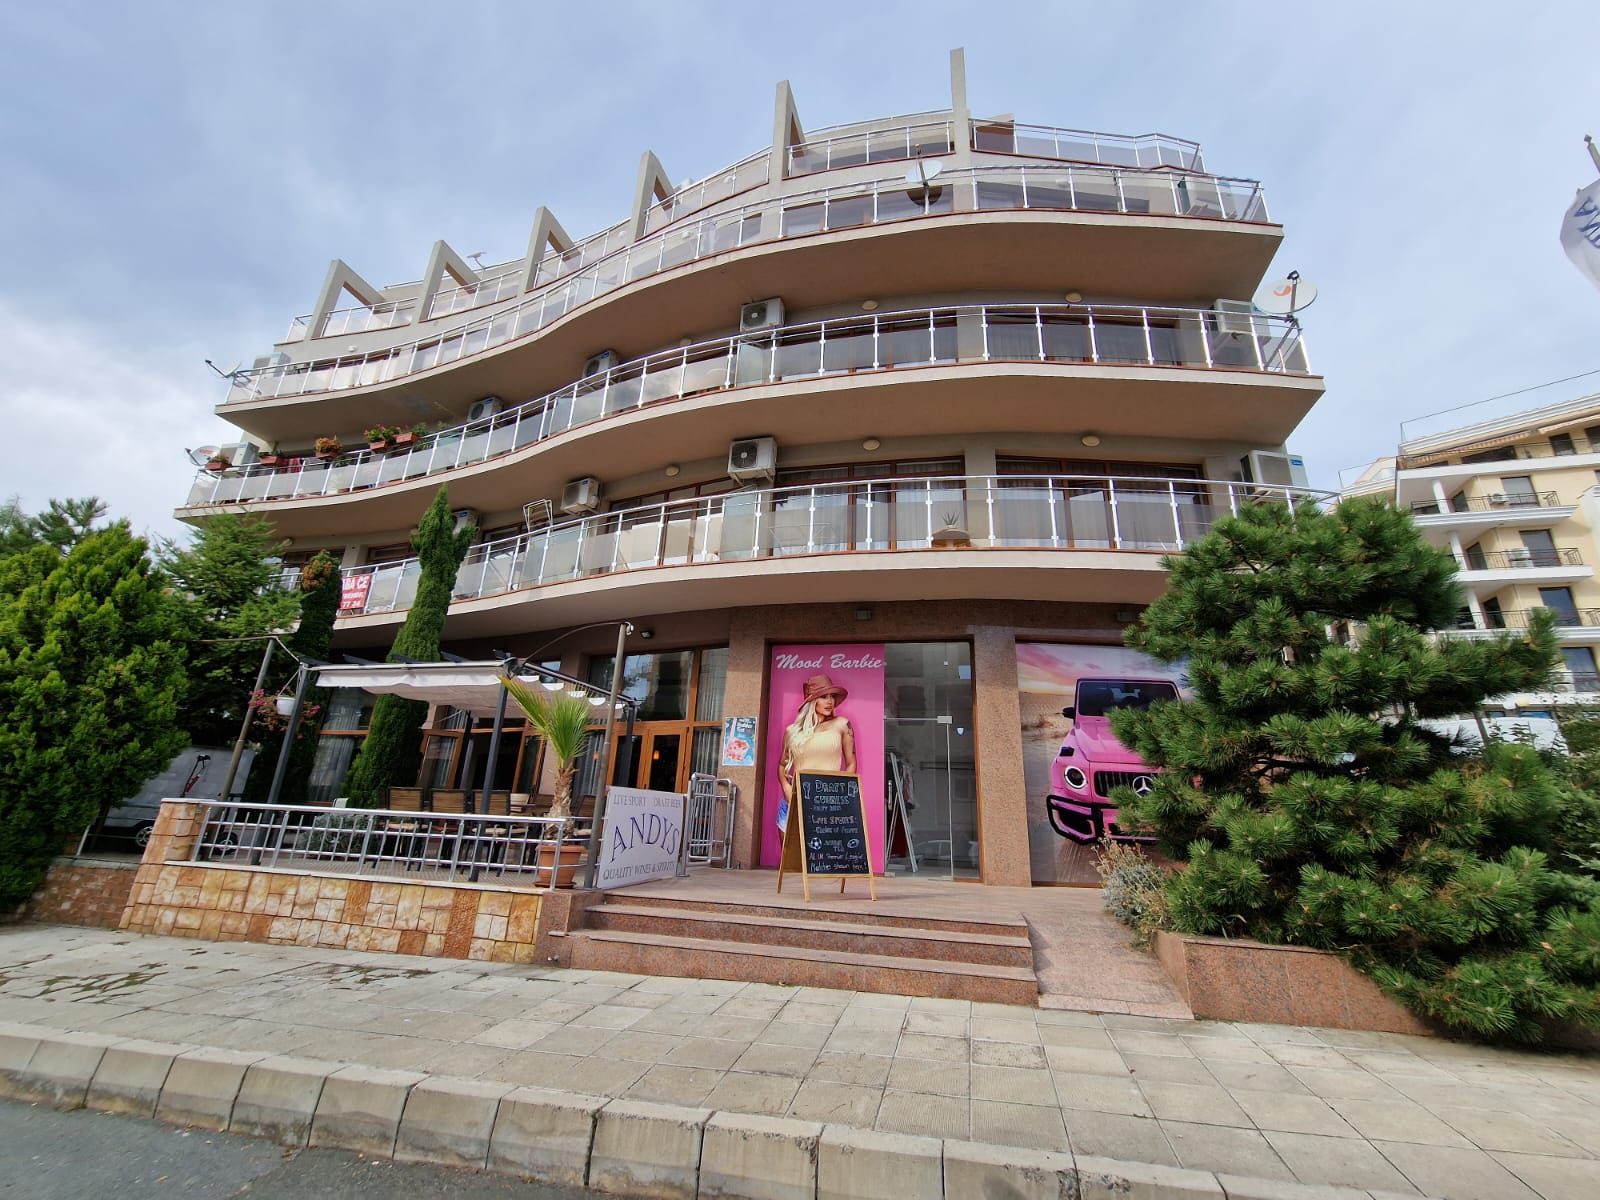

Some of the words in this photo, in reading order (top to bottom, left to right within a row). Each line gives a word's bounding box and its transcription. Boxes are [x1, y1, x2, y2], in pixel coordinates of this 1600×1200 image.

[775, 654, 824, 669] Mood
[830, 653, 882, 669] Barbie
[613, 794, 627, 806] LIVE
[628, 795, 646, 807] SPORT
[610, 812, 680, 863] ANDYS
[603, 865, 633, 880] QUALITY
